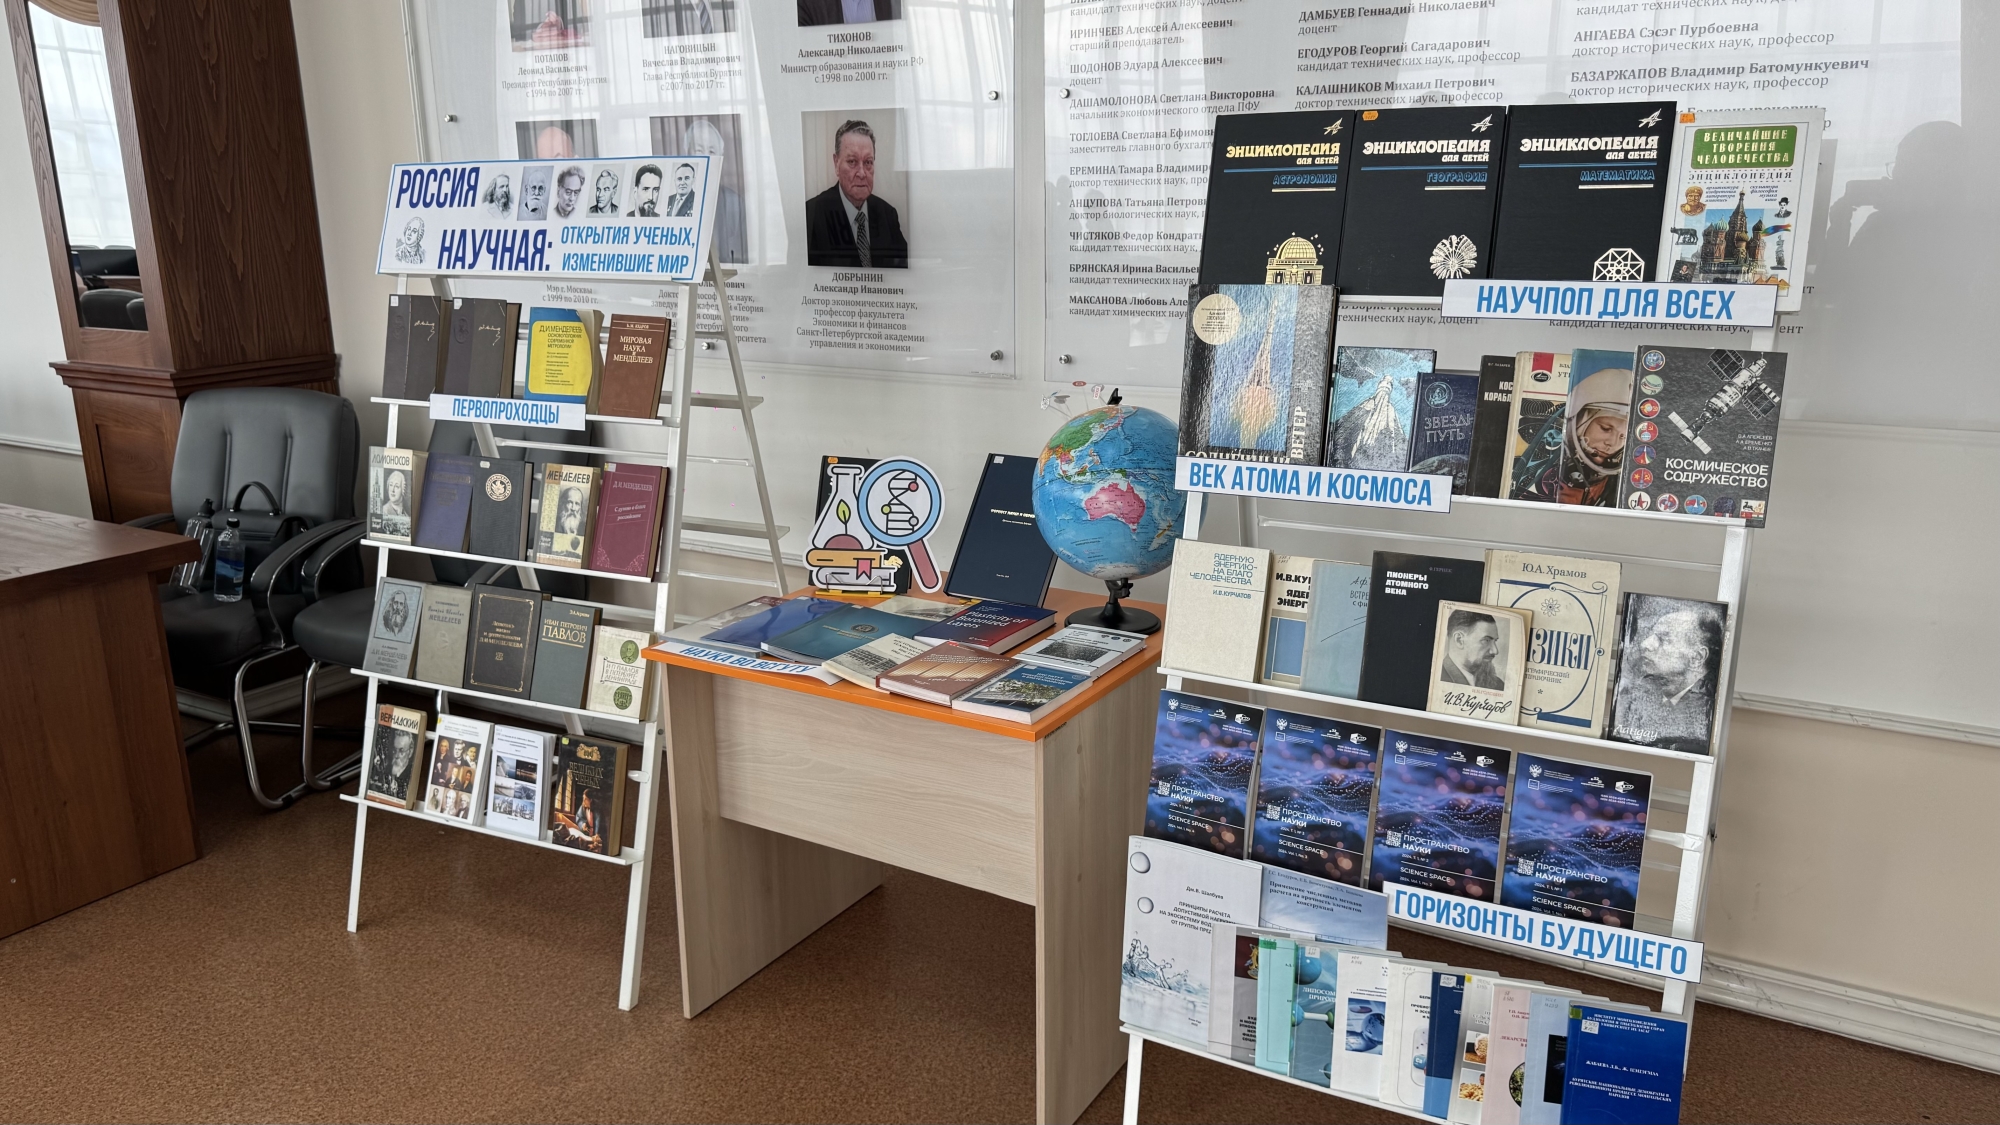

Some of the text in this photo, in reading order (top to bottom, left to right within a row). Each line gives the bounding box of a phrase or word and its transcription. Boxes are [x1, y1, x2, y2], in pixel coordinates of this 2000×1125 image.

[1298, 3, 1414, 23] ДАМБУЕВ Геннадий
[1070, 19, 1233, 39] ИРИНЧЕЕВ Алексей Алексеевич
[1298, 25, 1338, 36] доцент
[1574, 22, 1759, 43] АНГАЕВА Сэсэг Пурбоевна
[827, 31, 872, 43] ТИХОНОВ
[1622, 32, 1834, 54] исторических профессор
[664, 43, 717, 55] НАГОВИЦЫН
[798, 44, 904, 59] Александр Николаевич
[1298, 39, 1491, 59] ЕГОДУРОВ Георгий Сагадарович
[534, 53, 569, 64] ПОТАПОВ
[642, 55, 741, 68] Вячеслав Владимирович
[781, 57, 924, 74] Министр образования РФ
[1070, 56, 1222, 75] ШОДОНОВ Эдуард Алексеевич
[1297, 50, 1521, 72] кандидат профессор
[665, 70, 709, 81] Республики
[821, 71, 876, 83] 1998 2000
[1570, 58, 1870, 83] БАЗАРЖАПОВ Владимир Батомункуевич
[1296, 78, 1495, 96] КАЛАШНИКОВ Михаил Петрович
[1617, 74, 1829, 95] исторических профессор
[1069, 89, 1275, 109] ДАШАМОЛОНОВА Светлана Викторовна
[1441, 90, 1503, 102] профессор
[1121, 129, 1167, 140] Светлана
[1703, 129, 1789, 143] ВЕЛИЧАЙШИЕ
[1226, 142, 1341, 158] ЭНЦИКЛОПЕДИЯ
[1362, 139, 1491, 155] ЭНЦИКЛОПЕДИЯ
[1519, 136, 1660, 152] ЭНЦИКЛОПЕДИЯ
[1712, 142, 1777, 153] ТВОРЕНИЯ
[1696, 152, 1790, 165] ЧЕЛОВЕЧЕСТВА
[1070, 165, 1154, 175] ЕРЕМИНА Тамара
[1426, 172, 1488, 182] ГЕОГРАФИЯ
[1579, 169, 1656, 181] МАТЕМАТИКА
[1688, 171, 1793, 181] ЭНЦИКЛОПЕДИЯ
[1273, 173, 1338, 185] АСТРОНОМИЯ
[395, 166, 481, 209] РОССИЯ
[1124, 198, 1164, 208] Татьяна
[560, 226, 696, 249] ОТКРЫТИЯ УЧЕНЫХ,
[1069, 231, 1121, 241] ЧИСТЯКОВ
[437, 228, 554, 272] НАУЧНАЯ:
[561, 253, 690, 274] ИЗМЕНИВШИЕ МИР
[1070, 263, 1153, 274] БРЯНСКАЯ Ирина
[832, 272, 884, 283] ДОБРЫНИН
[813, 283, 904, 295] Александр Иванович
[1069, 295, 1168, 306] МАКСАНОВА Любовь
[1476, 285, 1736, 320] НАУЧПОП ДЛЯ ВСЕХ
[620, 336, 653, 346] МИРОВАЯ
[623, 344, 647, 353] НАУКА
[613, 354, 654, 365] МЕНДЕЛЕЕВ
[452, 398, 560, 424] ПЕРВОПРОХОДЦЫ
[1290, 406, 1310, 461] ВЕТЕР
[1426, 428, 1466, 443] ПУТЬ
[371, 453, 411, 466] ЛОМОНОСОВ
[1665, 457, 1769, 477] КОСМИЧЕСКОЕ
[546, 470, 591, 485] МЕНДЕЛЕЕВ
[1189, 462, 1432, 506] ВЕК АТОМА И КОСМОСА
[1664, 470, 1768, 489] СОДРУЖЕСТВО
[1213, 553, 1255, 564] ЯДЕРНУЮ
[1189, 572, 1252, 586] ЧЕЛОВЕЧЕСТВА
[1213, 568, 1253, 578] НА БЛАГО
[1386, 570, 1428, 582] ПИОНЕРЫ
[1546, 565, 1587, 580] Храмов
[1385, 579, 1429, 590] АТОМНОГО
[956, 615, 1011, 627] Boronized
[965, 611, 1014, 622] Plasticity
[544, 618, 588, 632] ИВАН ПЕТРОВИЧ
[946, 620, 982, 630] Layers
[542, 625, 587, 644] ПАВЛОВ
[680, 646, 735, 663] НАУКА
[734, 657, 752, 667] ВО
[380, 711, 419, 731] ВЕРНАДСКИЙ
[1170, 793, 1195, 804] НАУКИ
[1171, 784, 1225, 804] ПРОСТРАНСТВО
[1168, 814, 1210, 830] SCIENCE SPACE
[1281, 816, 1308, 828] НАУКИ
[1282, 808, 1343, 828] ПРОСТРАНСТВО
[1278, 839, 1325, 856] SCIENCE SPACE
[1402, 843, 1432, 855] НАУКИ
[1403, 834, 1470, 855] ПРОСТРАНСТВО
[1400, 866, 1451, 884] SCIENCE SPACE
[1534, 871, 1566, 884] НАУКИ
[1536, 862, 1608, 885] ПРОСТРАНСТВО
[1532, 896, 1588, 914] SCIENCE SPACE
[1394, 888, 1688, 975] ГОРИЗОНТЫ БУДУЩЕГО
